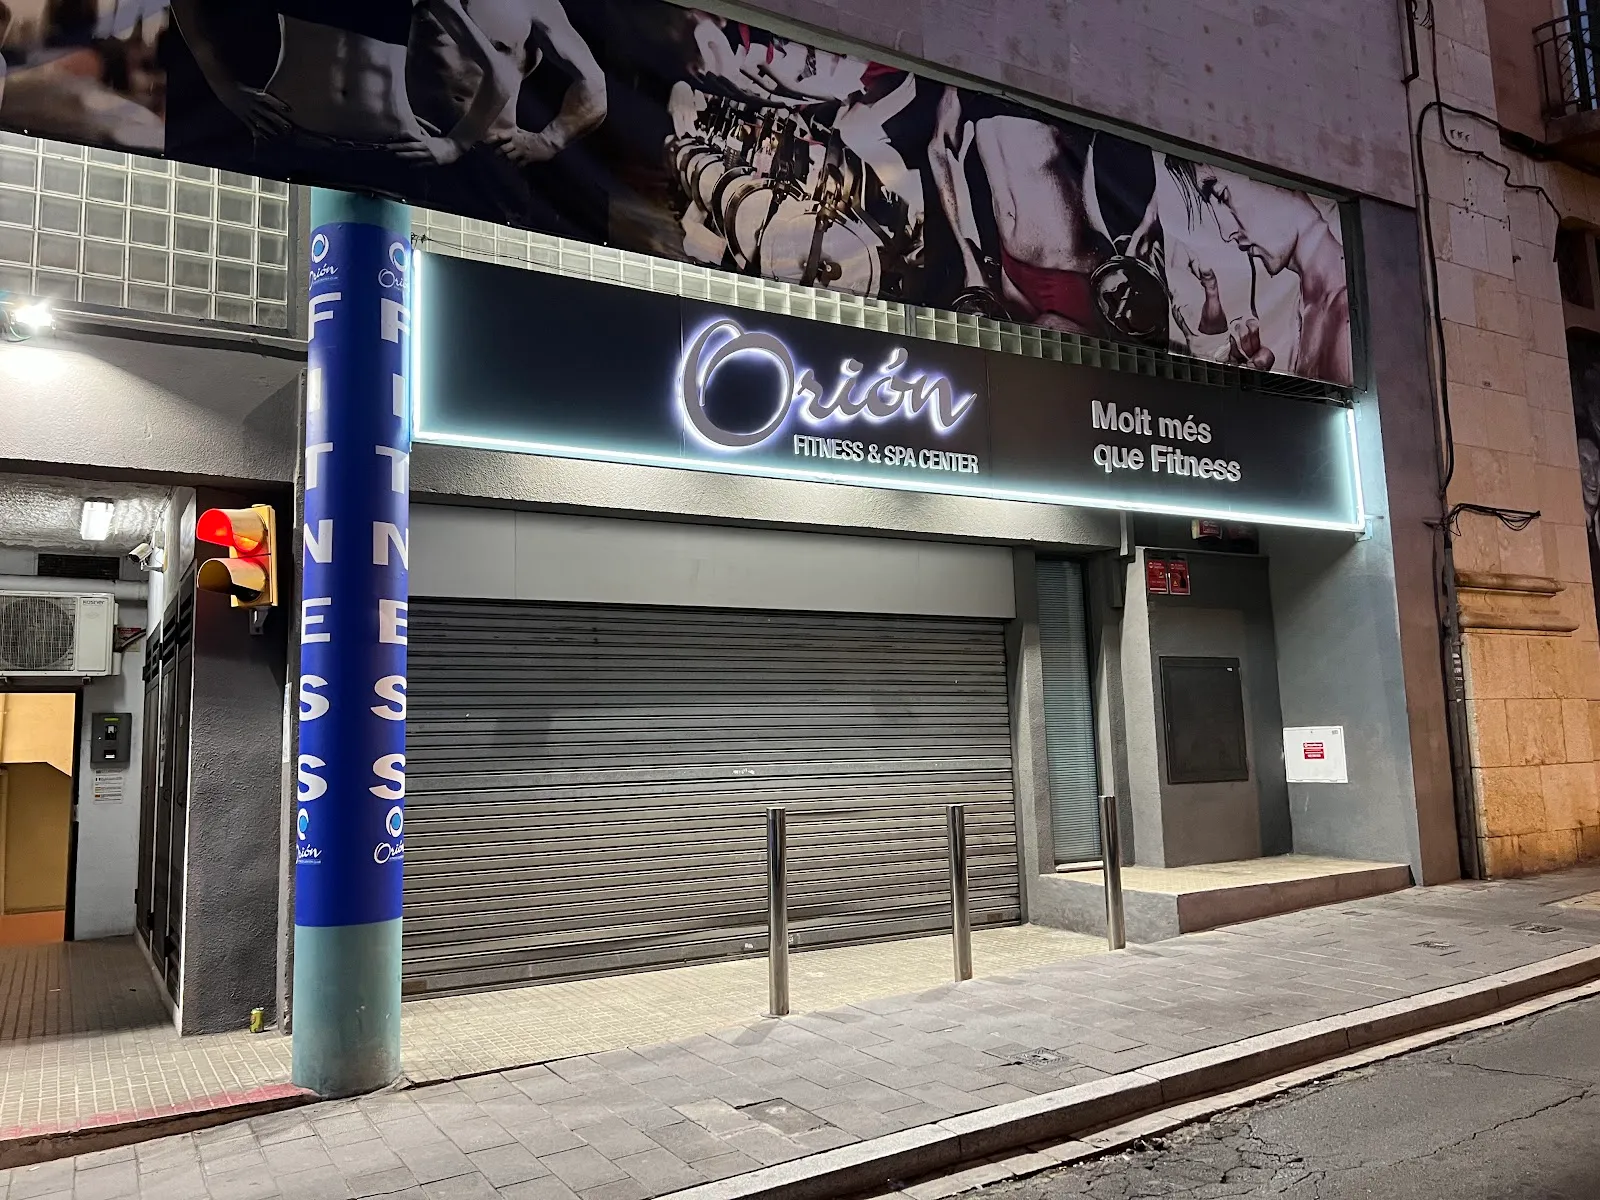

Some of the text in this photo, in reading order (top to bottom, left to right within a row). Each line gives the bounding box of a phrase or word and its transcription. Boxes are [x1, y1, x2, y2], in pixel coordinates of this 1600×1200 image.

[683, 318, 977, 448] Orión
[1091, 400, 1212, 444] Molt més
[793, 433, 979, 474] FITNESS & SPA CENTER
[1093, 443, 1242, 482] que Fitness
